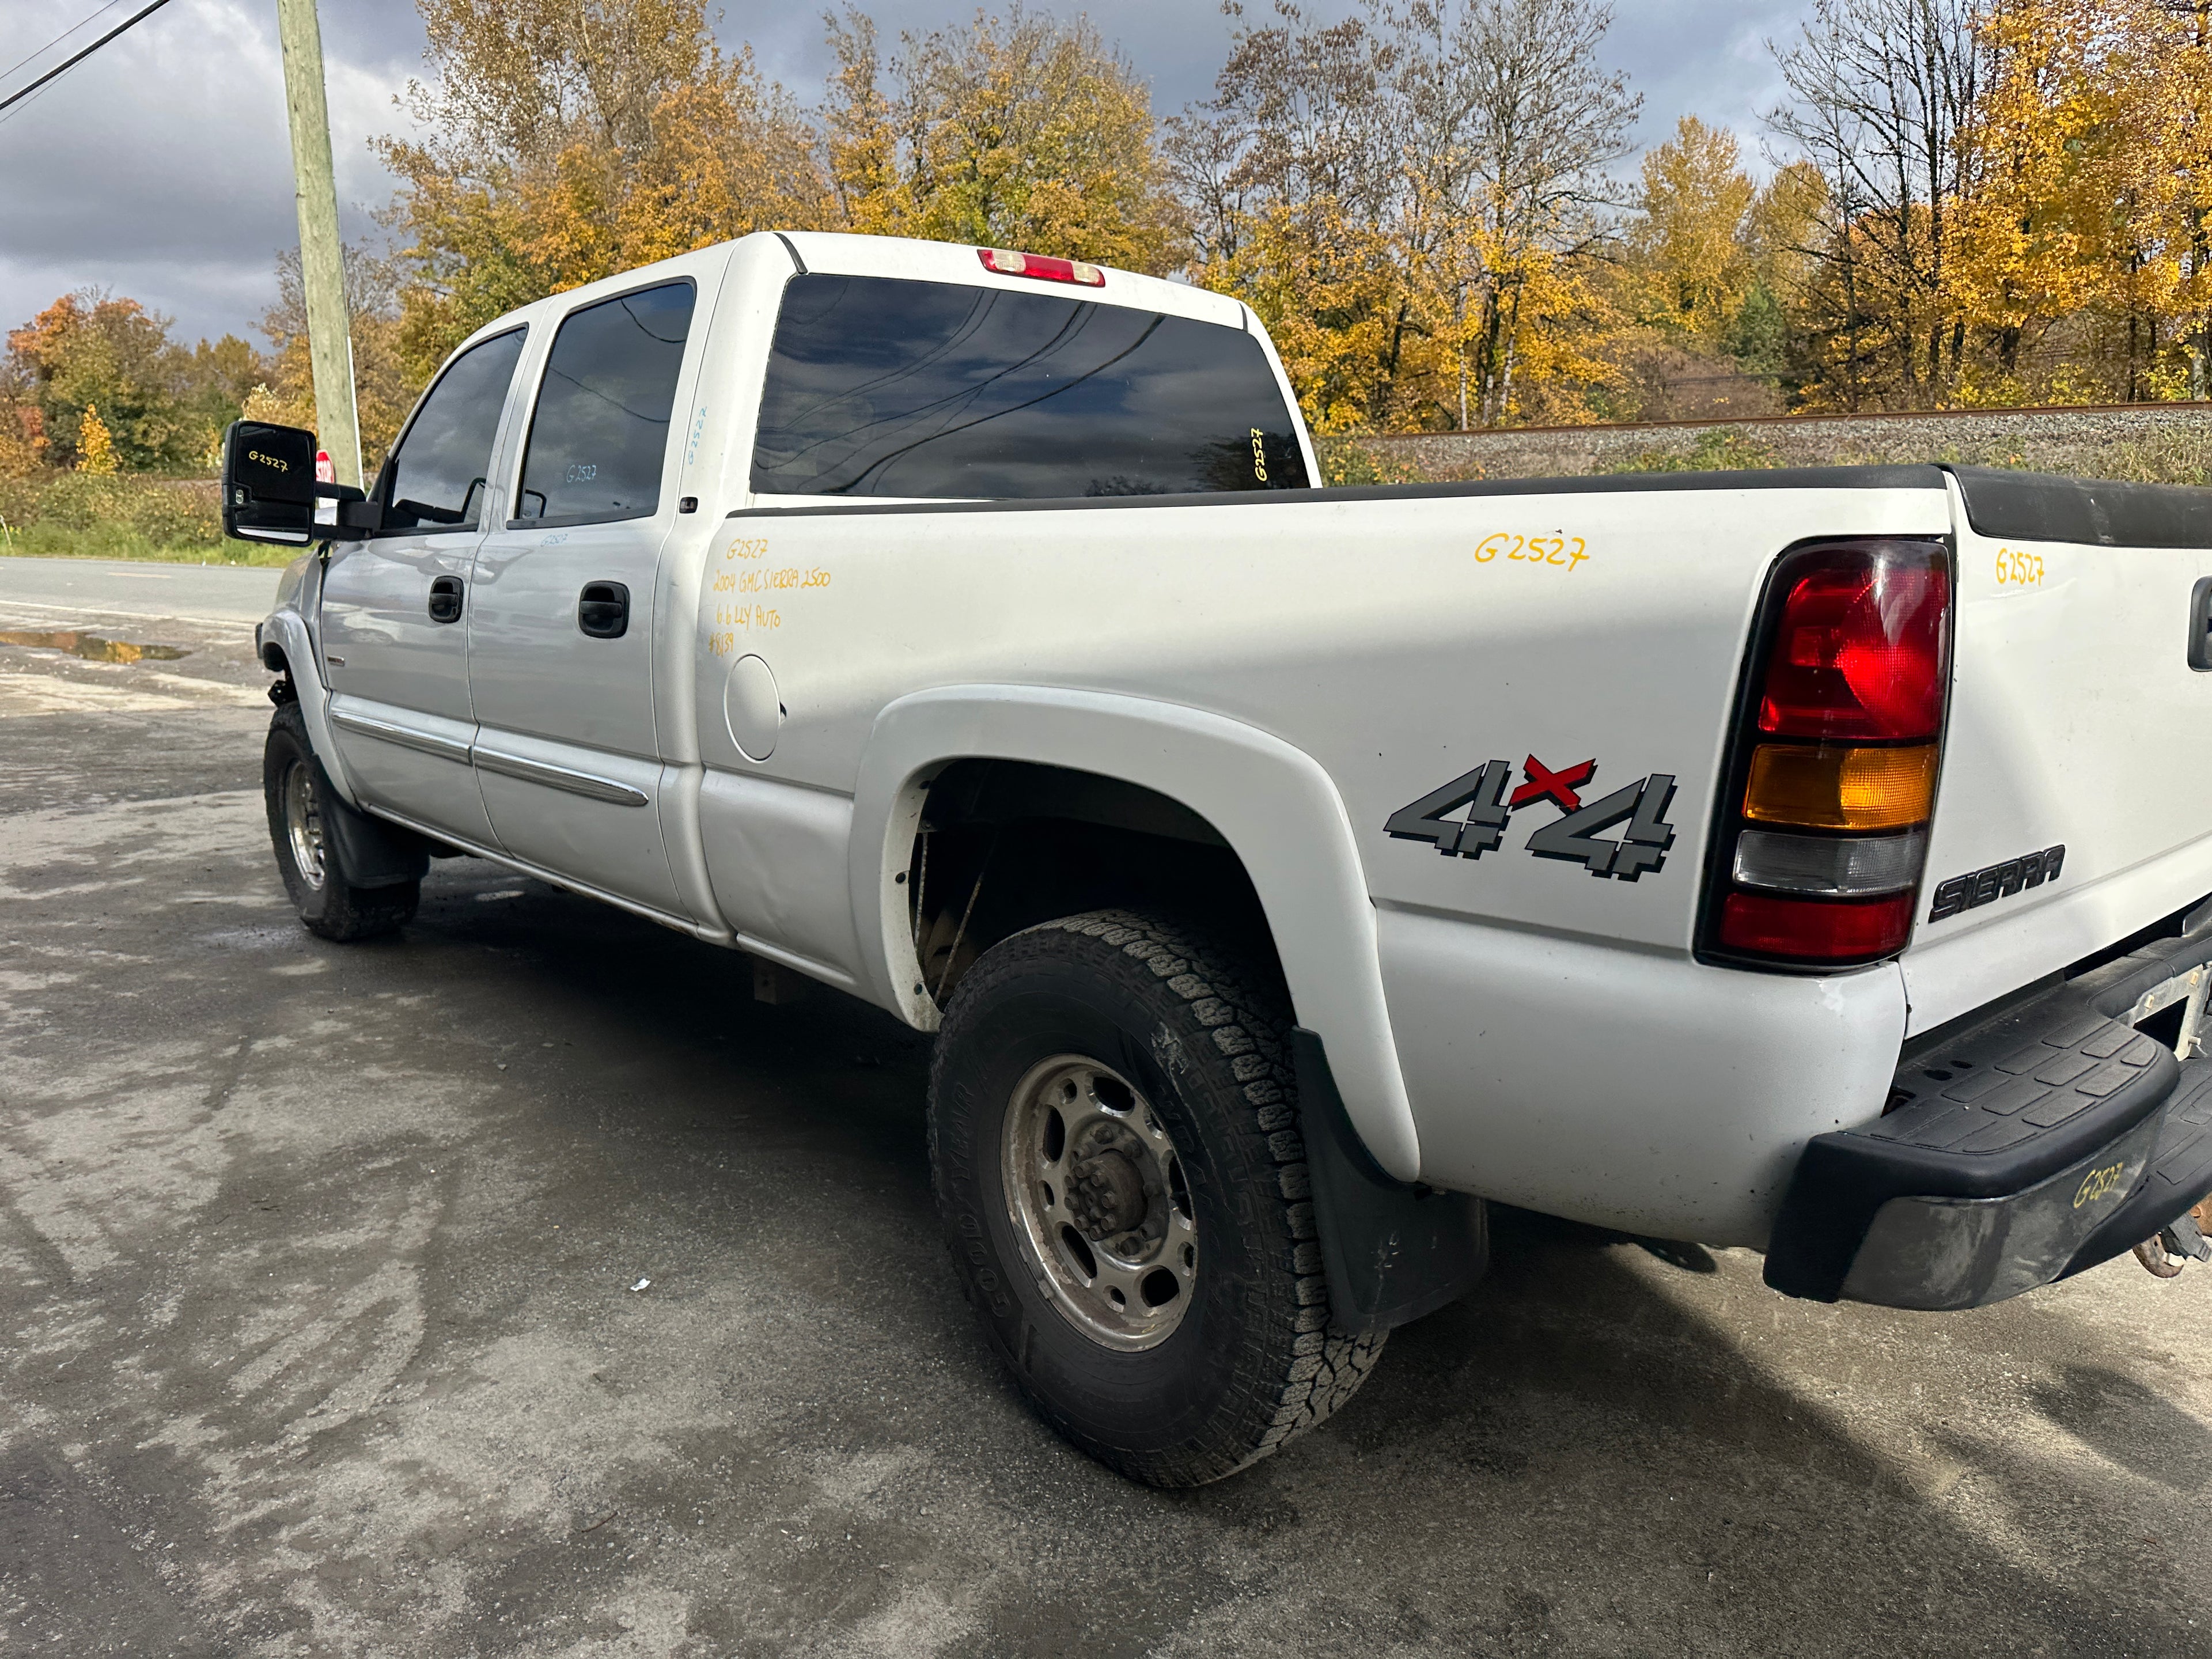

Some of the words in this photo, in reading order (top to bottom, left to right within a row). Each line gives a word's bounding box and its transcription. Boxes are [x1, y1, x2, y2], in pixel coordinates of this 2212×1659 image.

[248, 450, 288, 472] G2527
[1251, 427, 1268, 482] G2527
[566, 464, 597, 483] G2527
[726, 539, 768, 559] G2527
[1474, 532, 1590, 572] G2527
[713, 568, 736, 594] 2004
[739, 569, 763, 593] GMC
[800, 566, 831, 589] 2500
[1995, 548, 2044, 586] G2527
[717, 603, 732, 626] 6.6
[734, 603, 752, 631] LLY
[1927, 844, 2066, 925] SIERRA
[2074, 1161, 2123, 1209] G2527
